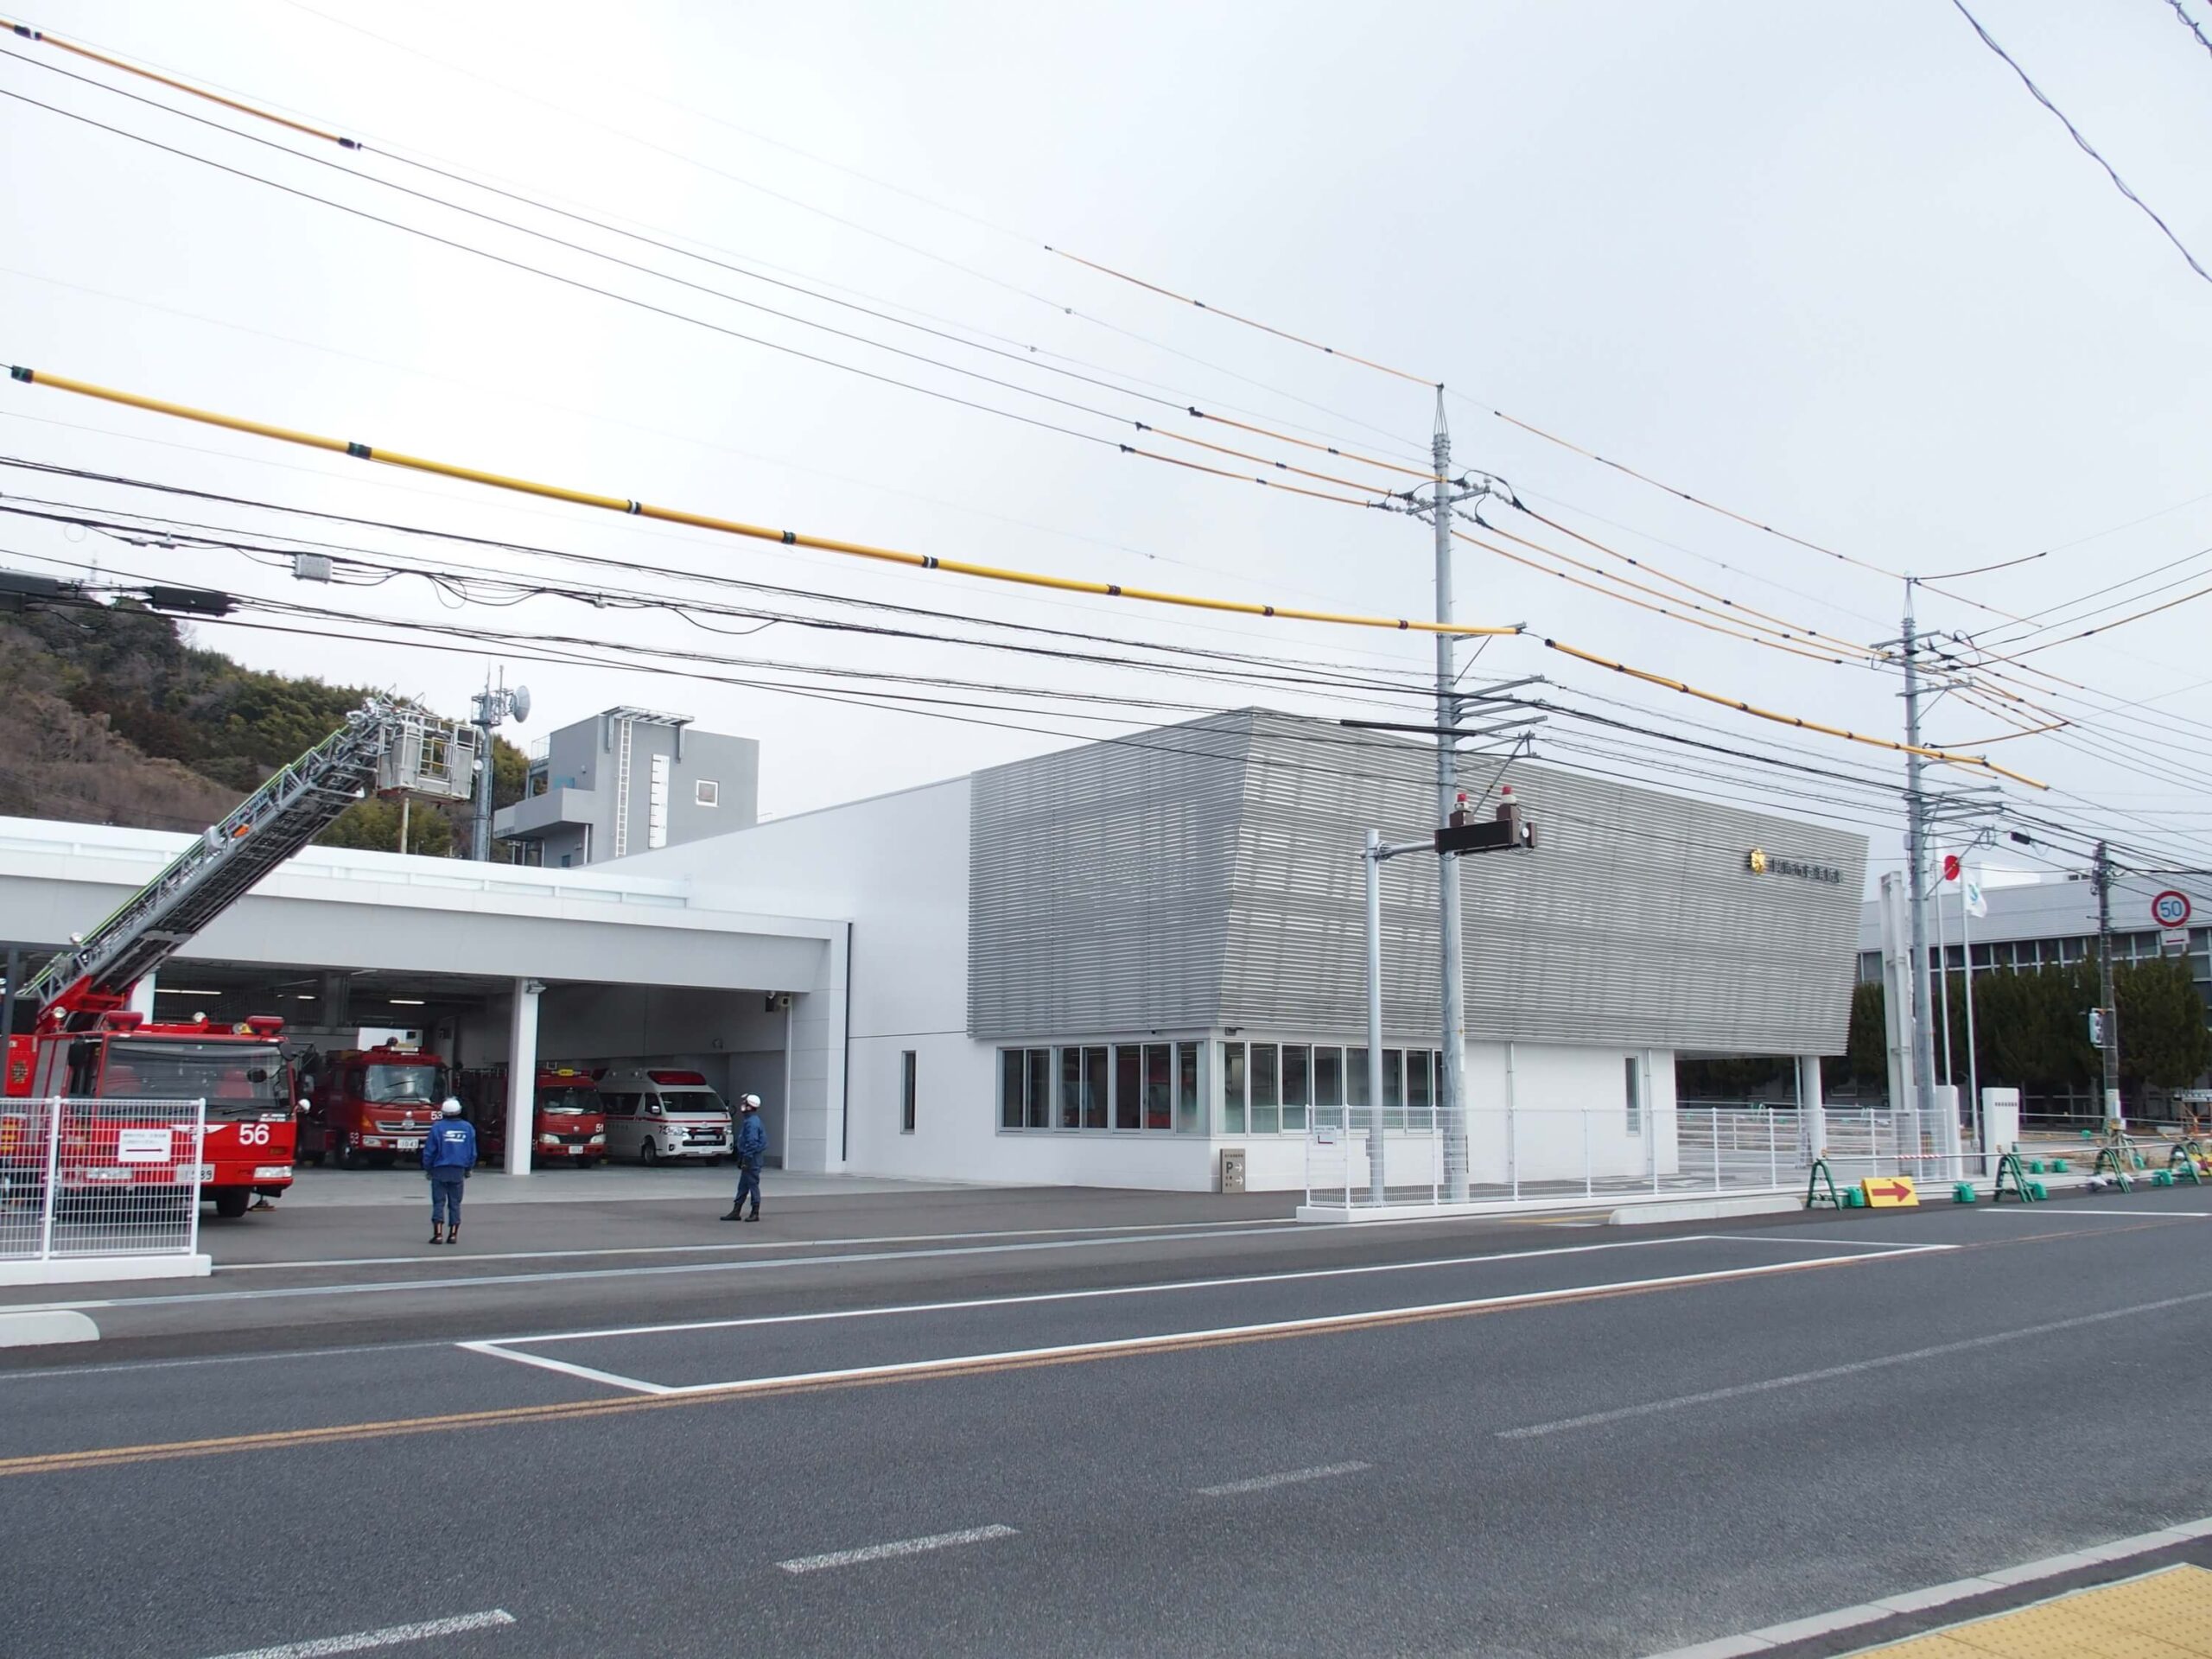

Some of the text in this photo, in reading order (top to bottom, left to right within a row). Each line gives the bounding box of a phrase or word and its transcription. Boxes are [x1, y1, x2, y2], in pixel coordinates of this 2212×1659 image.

[2160, 900, 2183, 918] 50
[430, 1110, 443, 1121] 53
[595, 1123, 604, 1133] 51
[239, 1124, 270, 1145] 56
[1226, 1161, 1233, 1173] P
